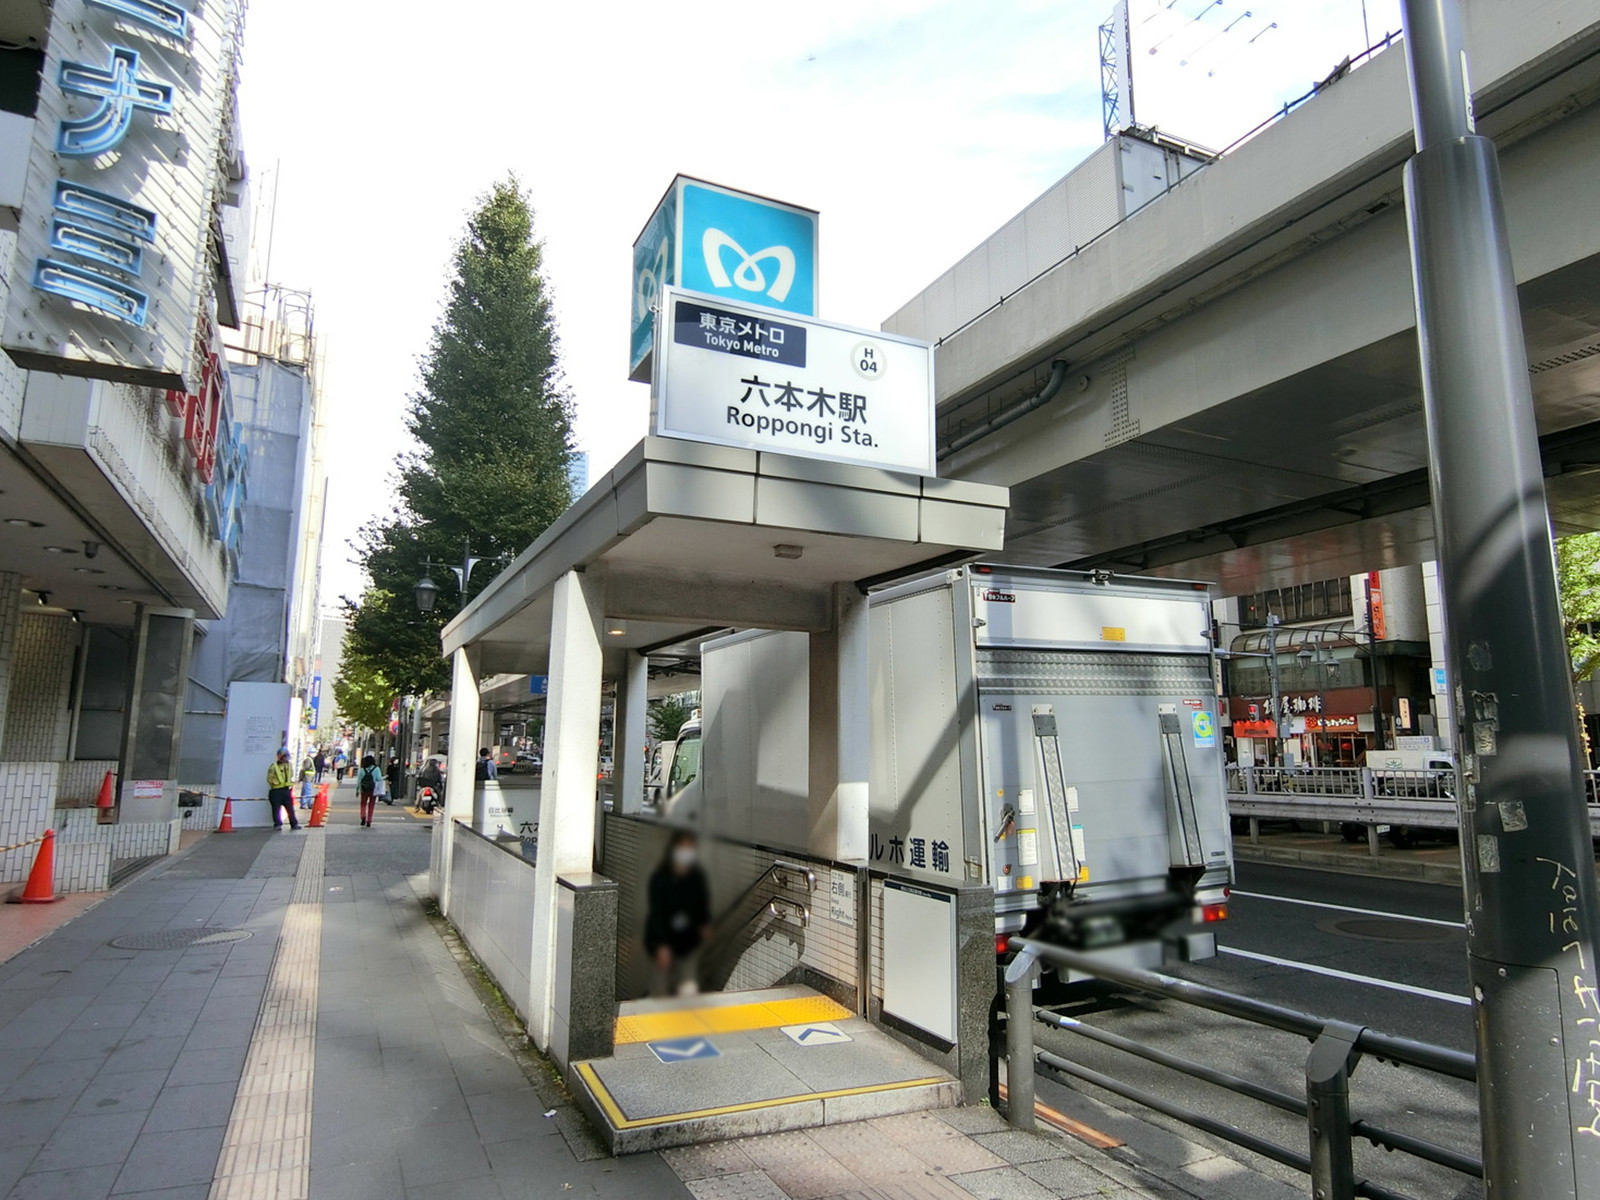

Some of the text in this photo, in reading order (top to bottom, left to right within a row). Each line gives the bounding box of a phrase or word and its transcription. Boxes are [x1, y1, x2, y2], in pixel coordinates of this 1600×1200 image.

[698, 312, 785, 345] 東京メトロ
[704, 331, 780, 358] Tokyo Metro
[859, 359, 878, 374] 04
[864, 348, 874, 359] H
[740, 375, 868, 425] 六本木駅
[726, 405, 879, 448] Roppongi Sta.
[870, 833, 950, 873] ルホ運輸
